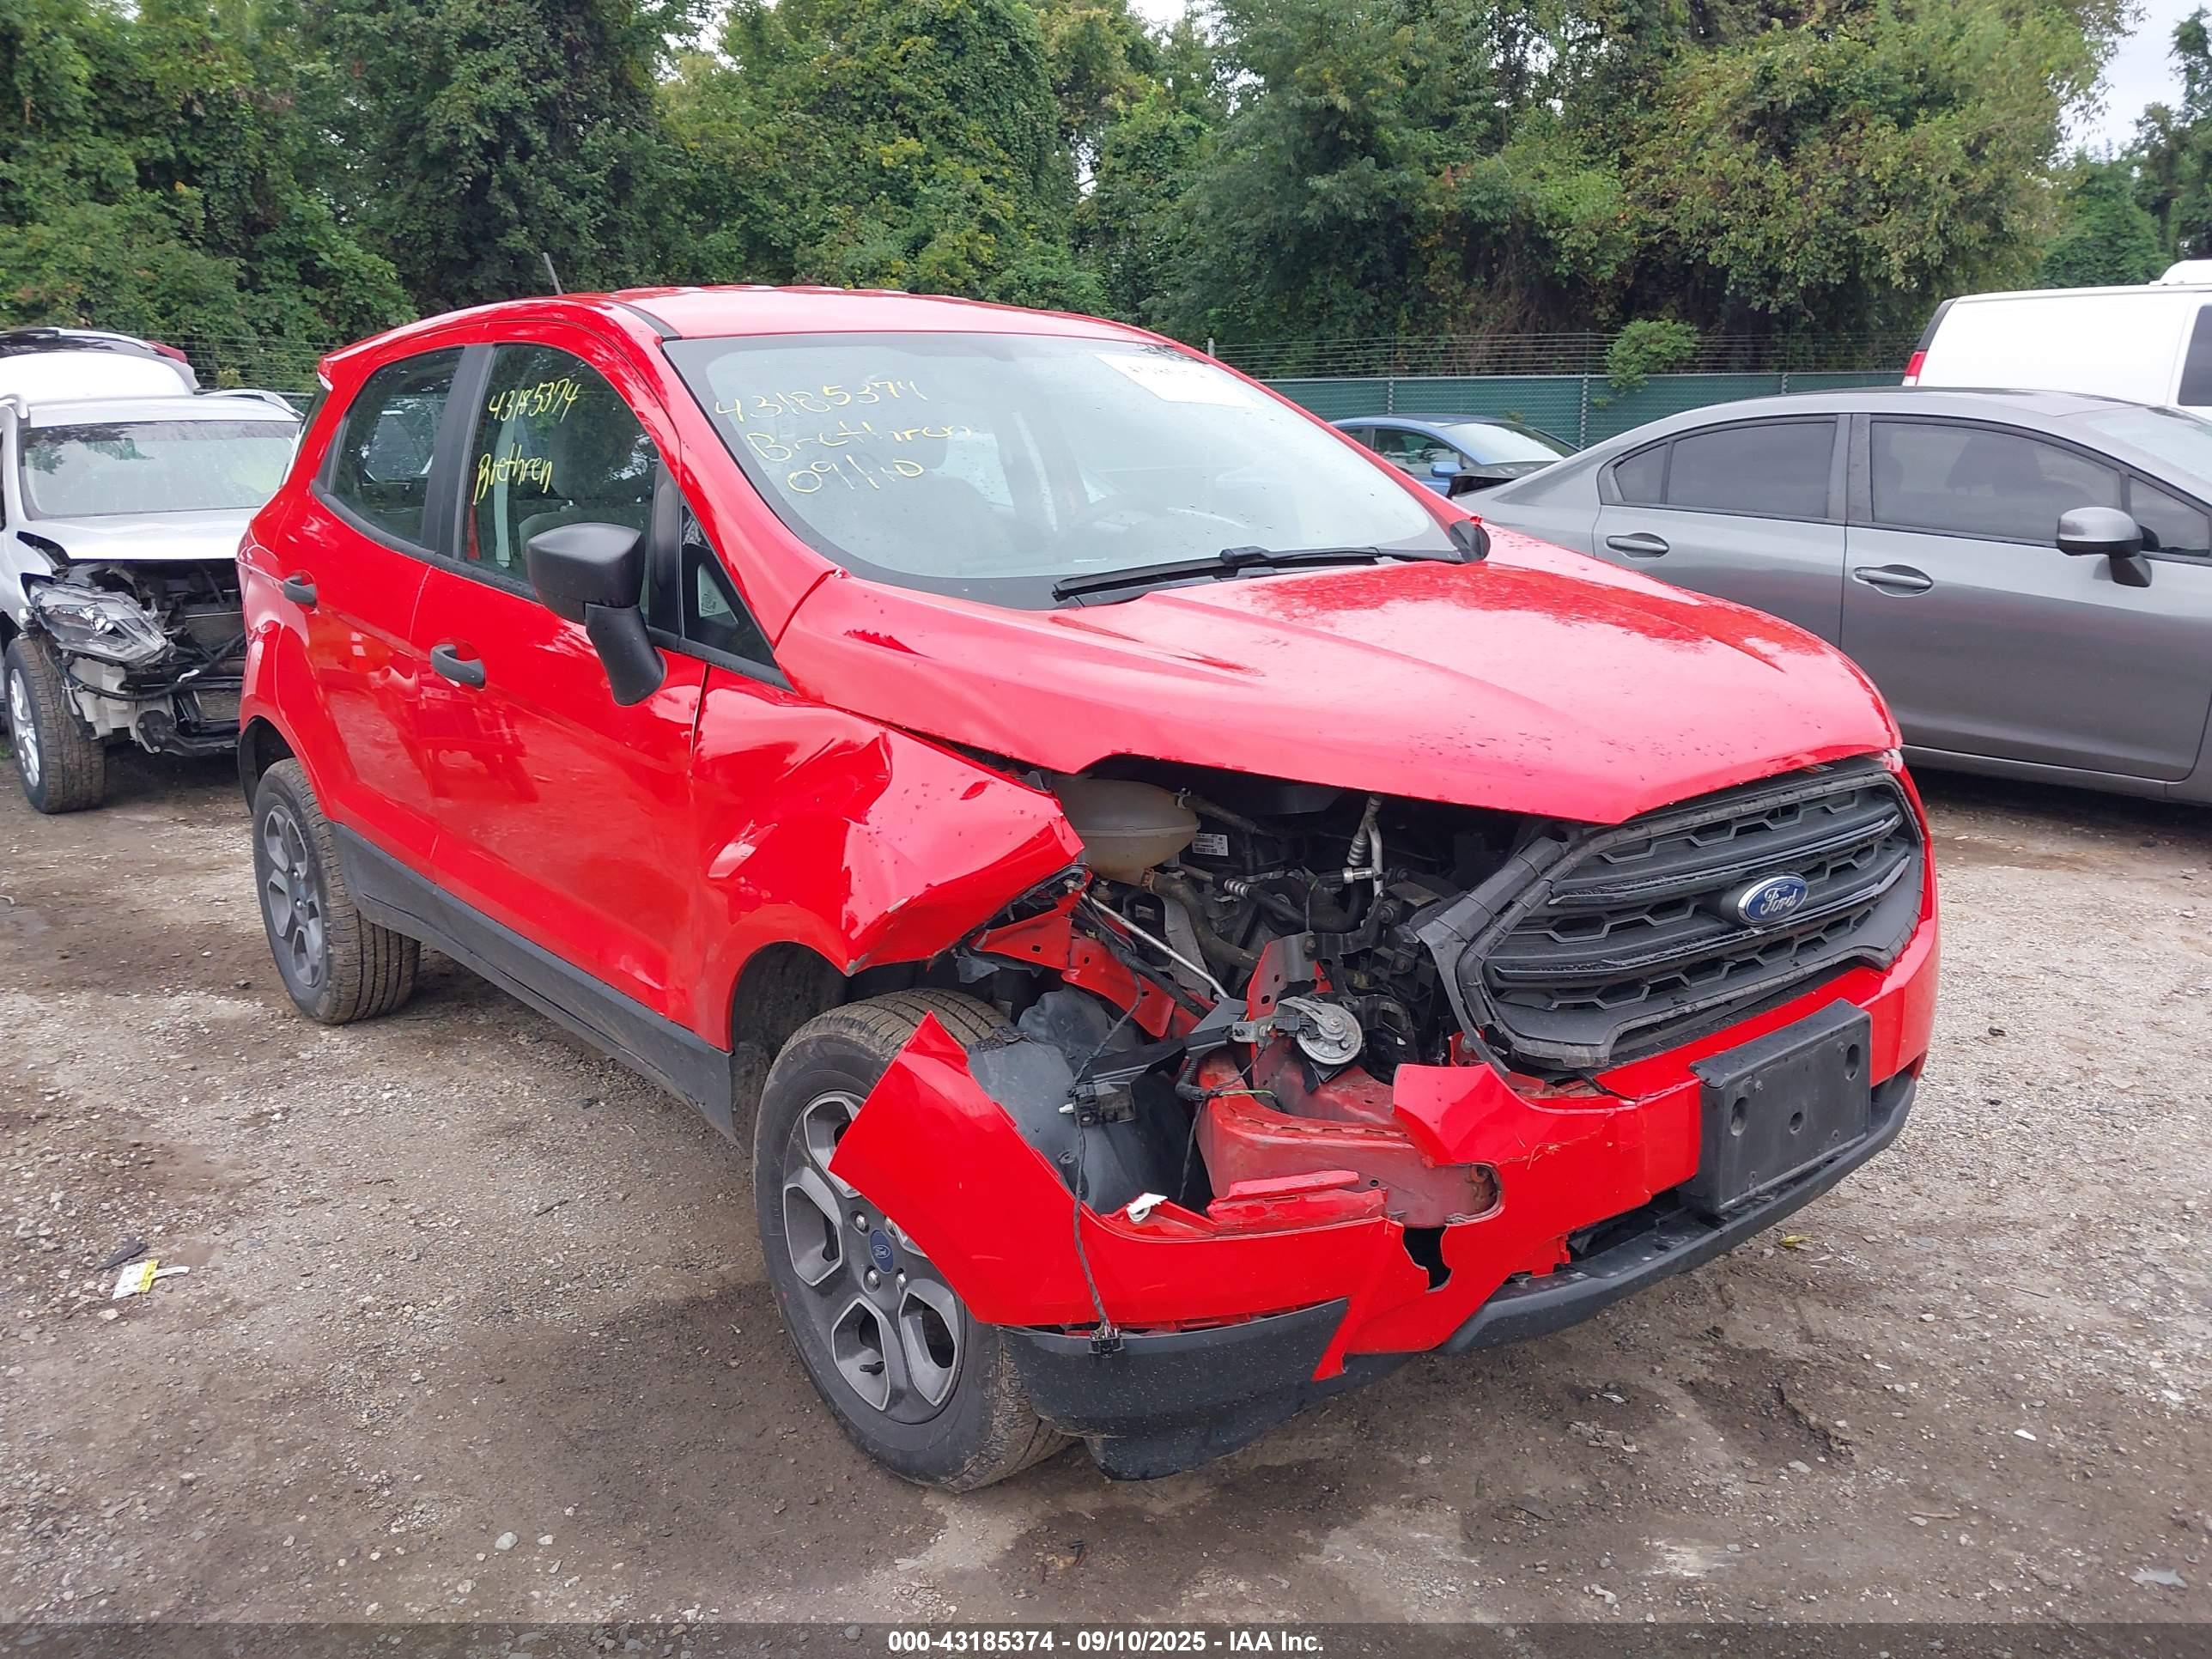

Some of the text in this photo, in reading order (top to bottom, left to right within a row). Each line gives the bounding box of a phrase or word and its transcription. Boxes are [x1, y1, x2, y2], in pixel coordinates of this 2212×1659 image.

[488, 378, 582, 423] 43185374
[472, 442, 553, 506] Brethren
[1759, 884, 1798, 915] Ford
